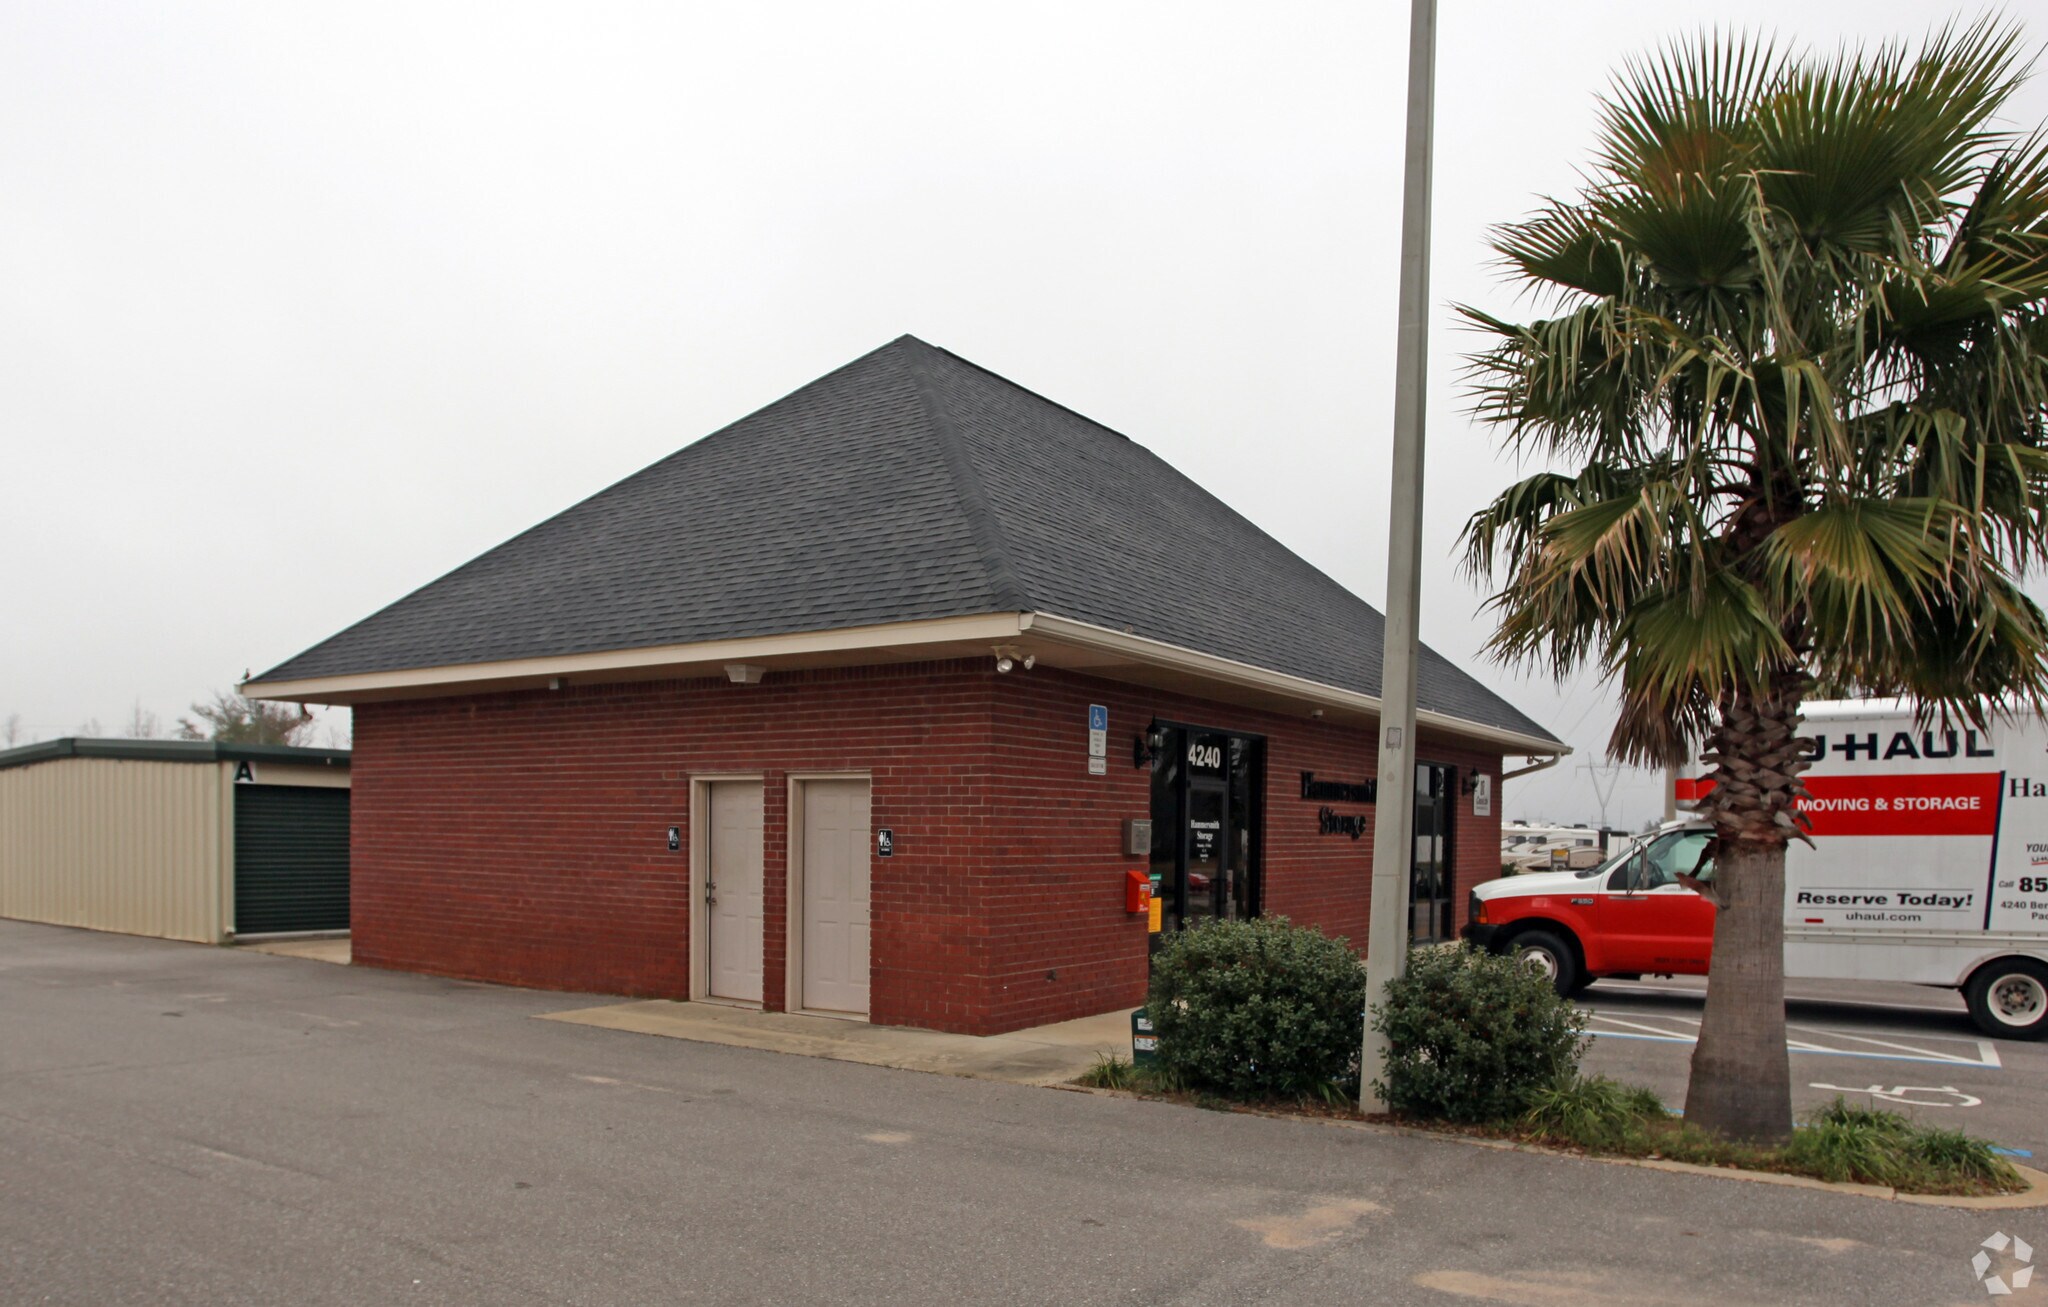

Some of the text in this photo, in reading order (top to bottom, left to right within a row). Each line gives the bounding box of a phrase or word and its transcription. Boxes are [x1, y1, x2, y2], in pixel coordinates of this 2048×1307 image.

[1188, 743, 1221, 769] 4240
[233, 760, 254, 782] A
[1797, 796, 1981, 812] MOVING & STORAGE
[2026, 843, 2048, 853] YOU
[1999, 880, 2015, 888] Call
[1797, 892, 1974, 909] Reserve Today!
[2000, 900, 2027, 909] 4240
[1846, 912, 1922, 922] uhaul.com
